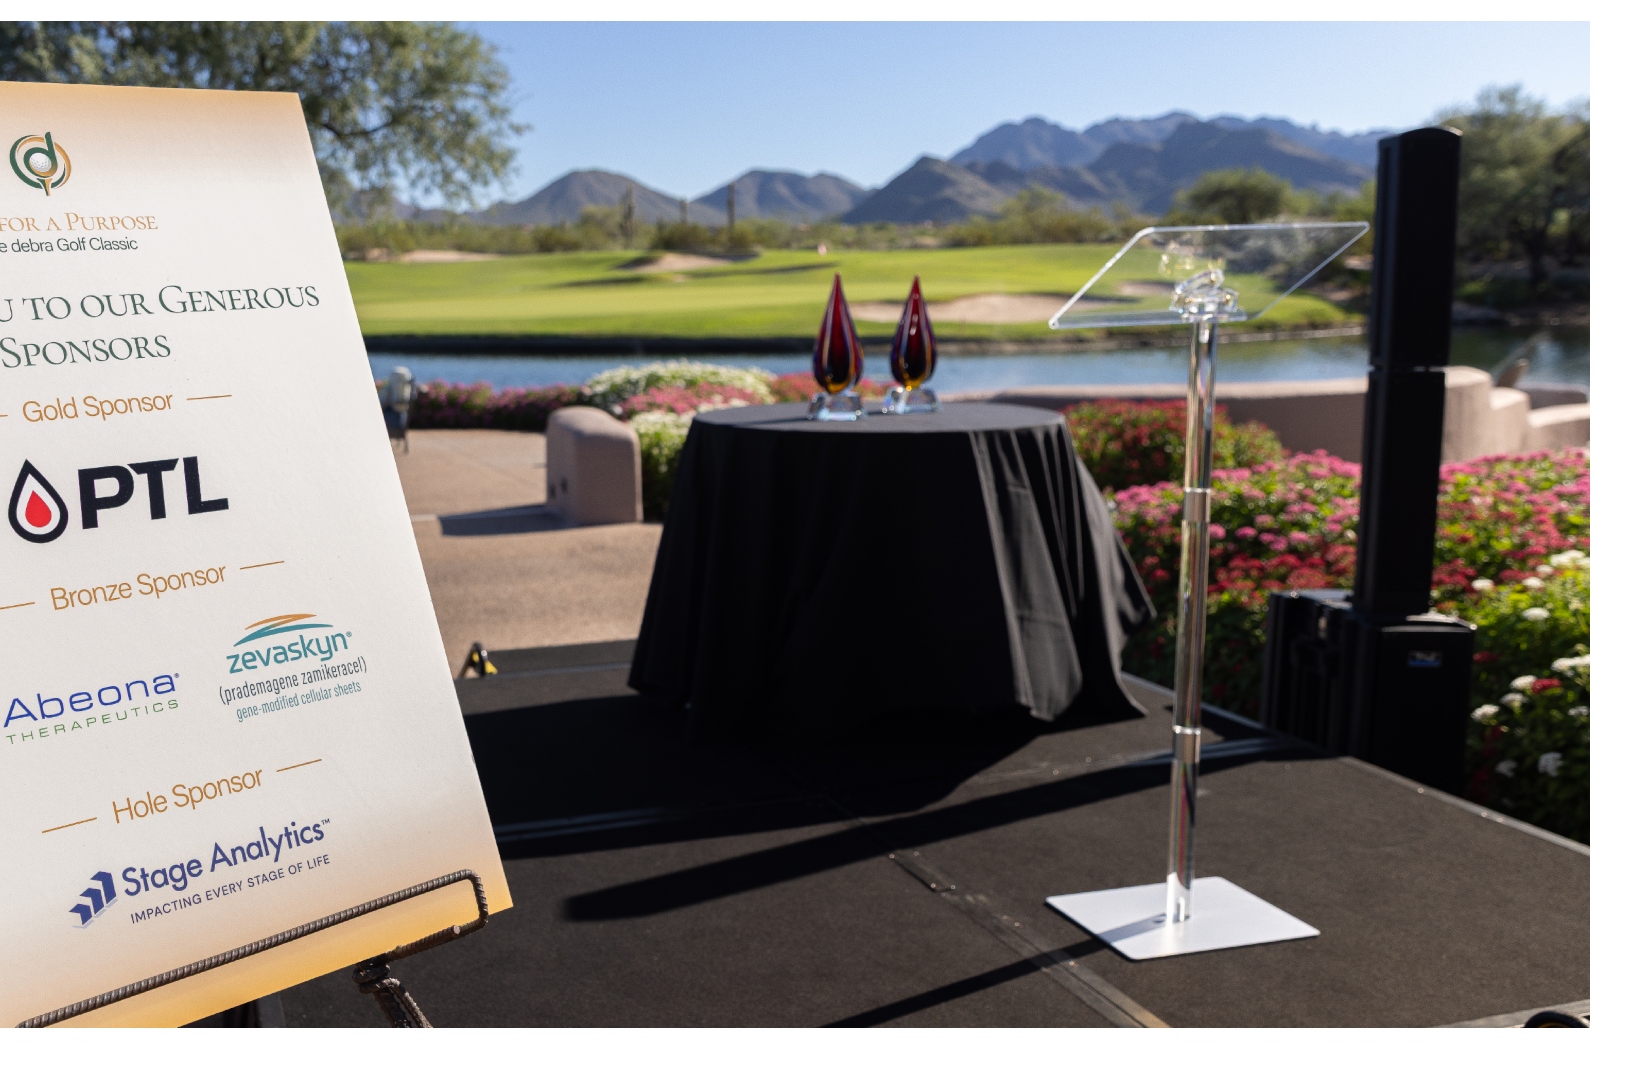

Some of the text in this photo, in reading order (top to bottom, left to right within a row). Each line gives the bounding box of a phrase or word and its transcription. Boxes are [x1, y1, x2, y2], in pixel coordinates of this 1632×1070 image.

[11, 239, 54, 252] debra
[57, 238, 86, 251] Golf
[90, 237, 138, 251] Classic
[46, 217, 62, 231] A
[22, 296, 71, 321] TO
[80, 293, 154, 318] OUR
[159, 285, 319, 314] GENEROUS
[0, 335, 171, 368] SPONSORS
[22, 394, 173, 422] Gold Sponsor
[78, 456, 229, 530] PTL
[50, 565, 227, 612] Bronze Sponsor
[219, 656, 367, 706] (prademagene zamikeracel)
[237, 681, 361, 722] gene-modified cellular sheets
[6, 700, 179, 744] THERAPEUTICS
[112, 769, 262, 823] Hole Sponsor
[121, 859, 203, 897] Stage
[130, 854, 330, 924] IMPACTING EVERY STAGE OF LIFE
